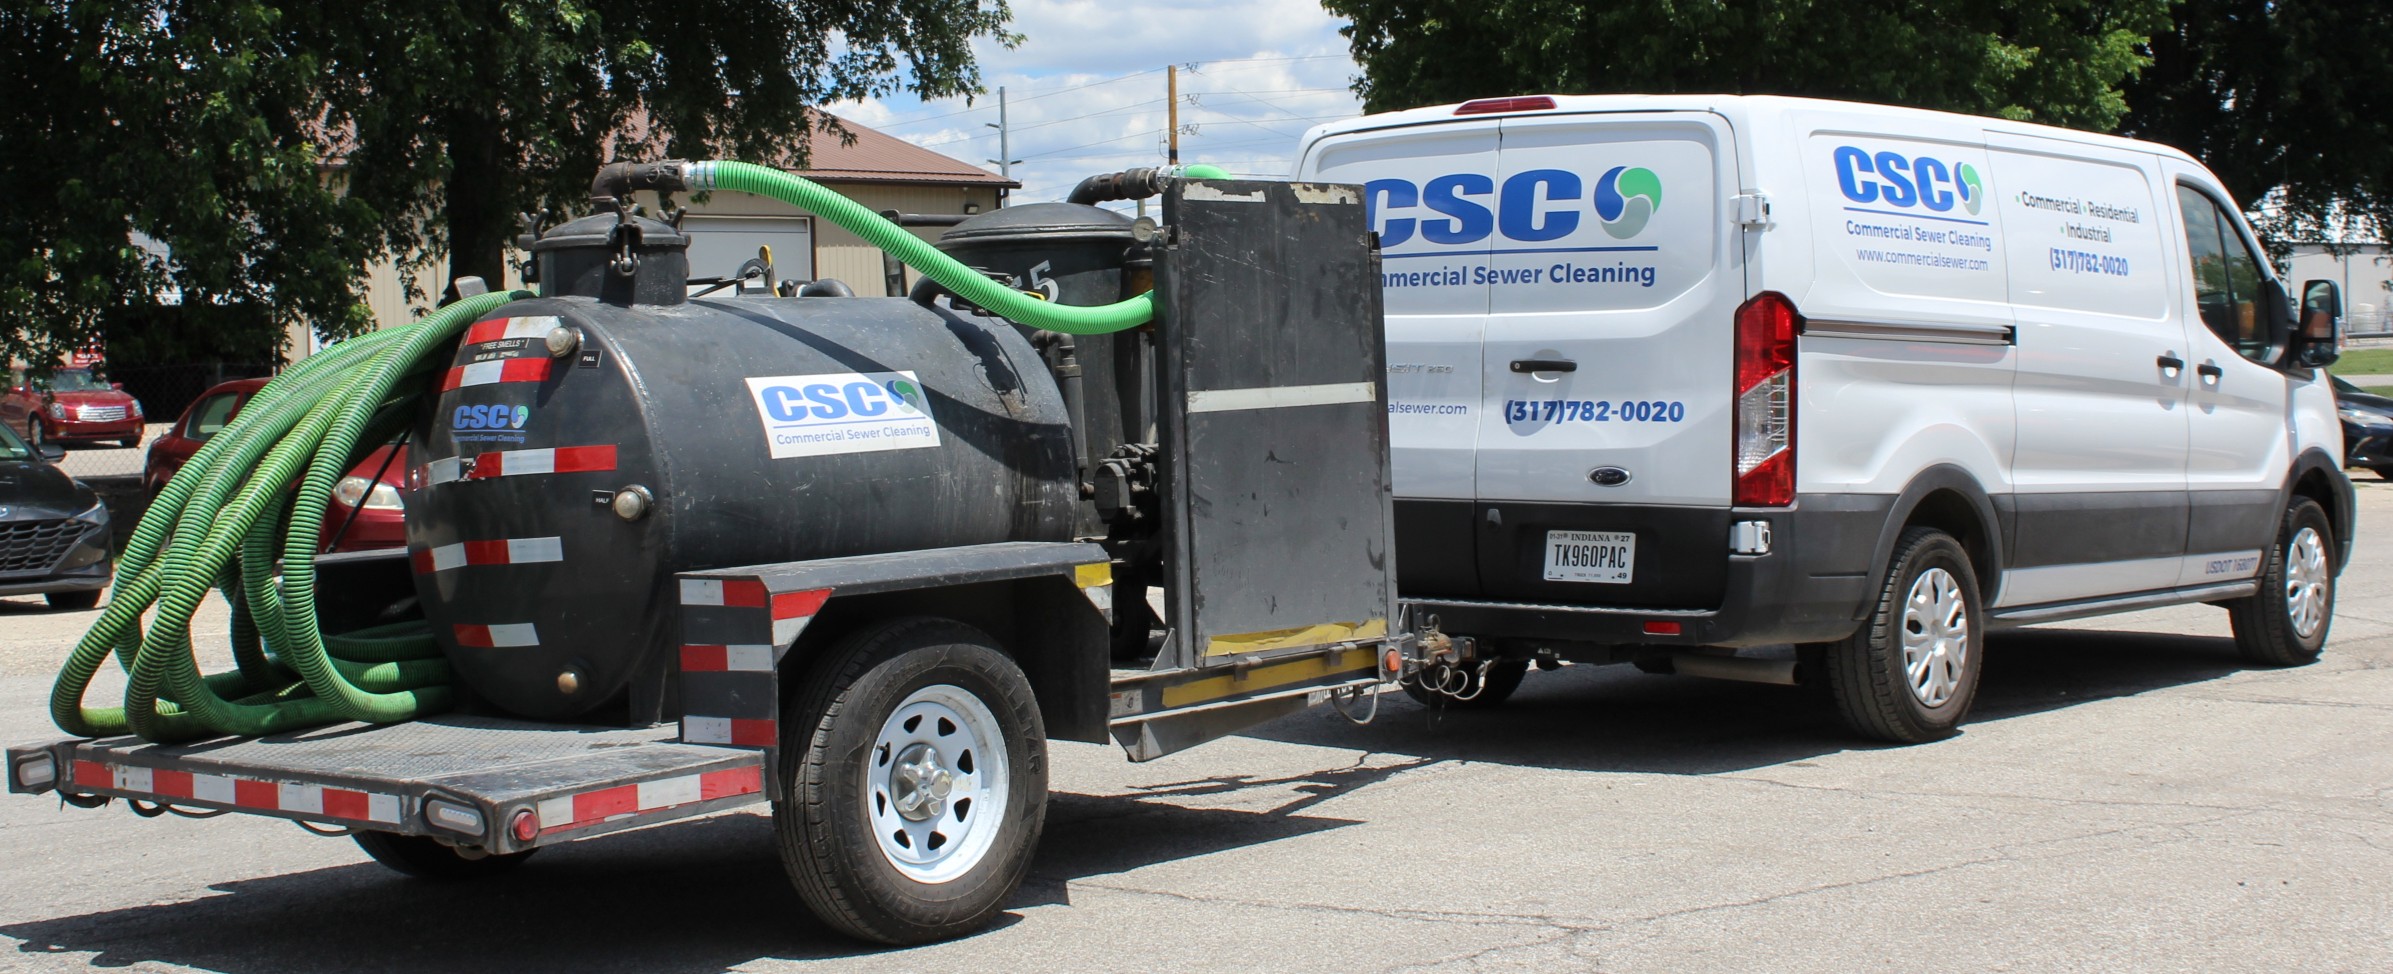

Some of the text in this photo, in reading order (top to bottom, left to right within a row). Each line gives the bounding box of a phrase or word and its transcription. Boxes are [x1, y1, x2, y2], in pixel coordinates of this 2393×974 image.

[1833, 145, 1955, 213] CSC
[1365, 168, 1582, 248] CSC
[2021, 191, 2139, 224] Commercial Residential
[1846, 219, 1992, 252] Commercial Sewer Cleaning
[2065, 221, 2112, 243] Industrial
[1856, 248, 1989, 272] www.commercialsewer.com
[2049, 247, 2129, 276] (317)782-0020
[1381, 262, 1656, 288] mercial Sewer Cleaning
[762, 382, 888, 422] CSC
[1388, 401, 1467, 415] alsewer.com
[1505, 400, 1685, 424] (317)782-0020
[453, 404, 510, 430] CSC
[777, 424, 931, 445] Commercial Sewer Cleaning
[1571, 533, 1611, 542] INDIANA
[1554, 544, 1627, 568] TK960PAC
[1617, 572, 1628, 580] 49
